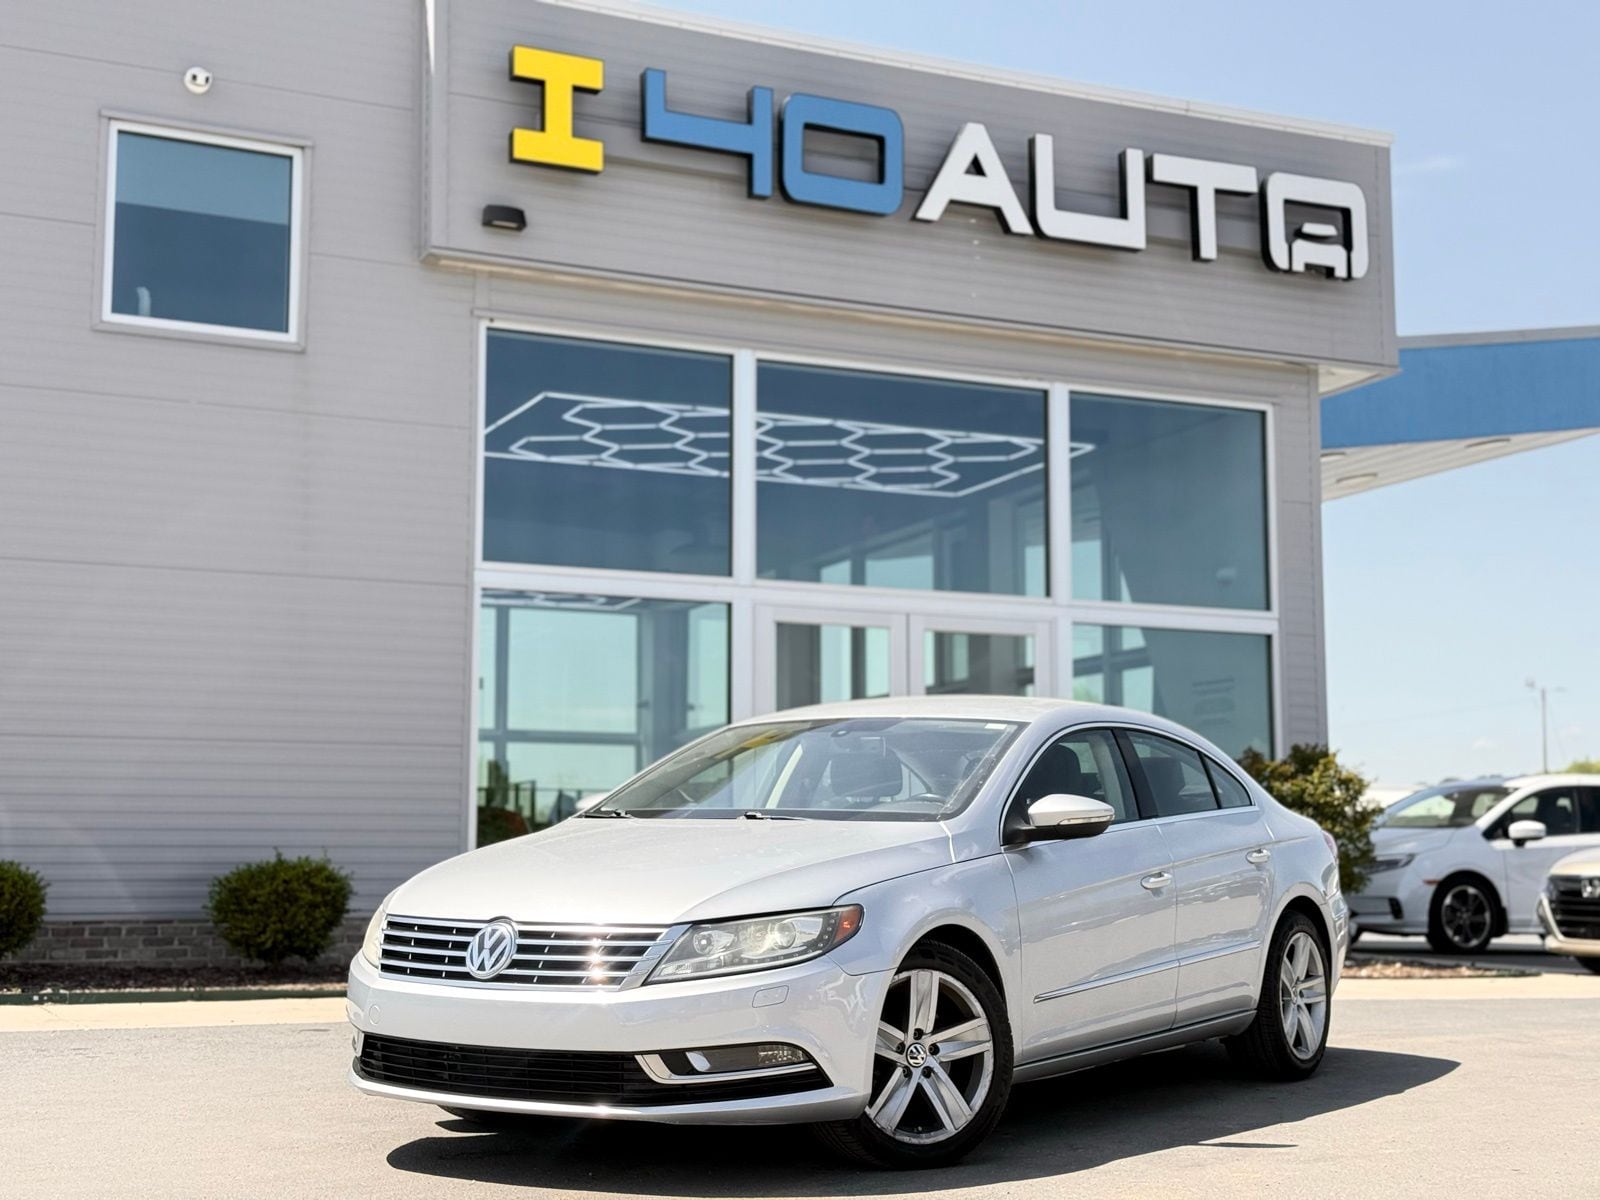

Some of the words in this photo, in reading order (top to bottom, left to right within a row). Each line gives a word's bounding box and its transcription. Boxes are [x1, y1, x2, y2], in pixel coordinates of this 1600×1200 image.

[511, 45, 605, 172] I
[642, 70, 904, 215] 40
[917, 123, 1368, 280] AUTO
[467, 923, 511, 976] VW
